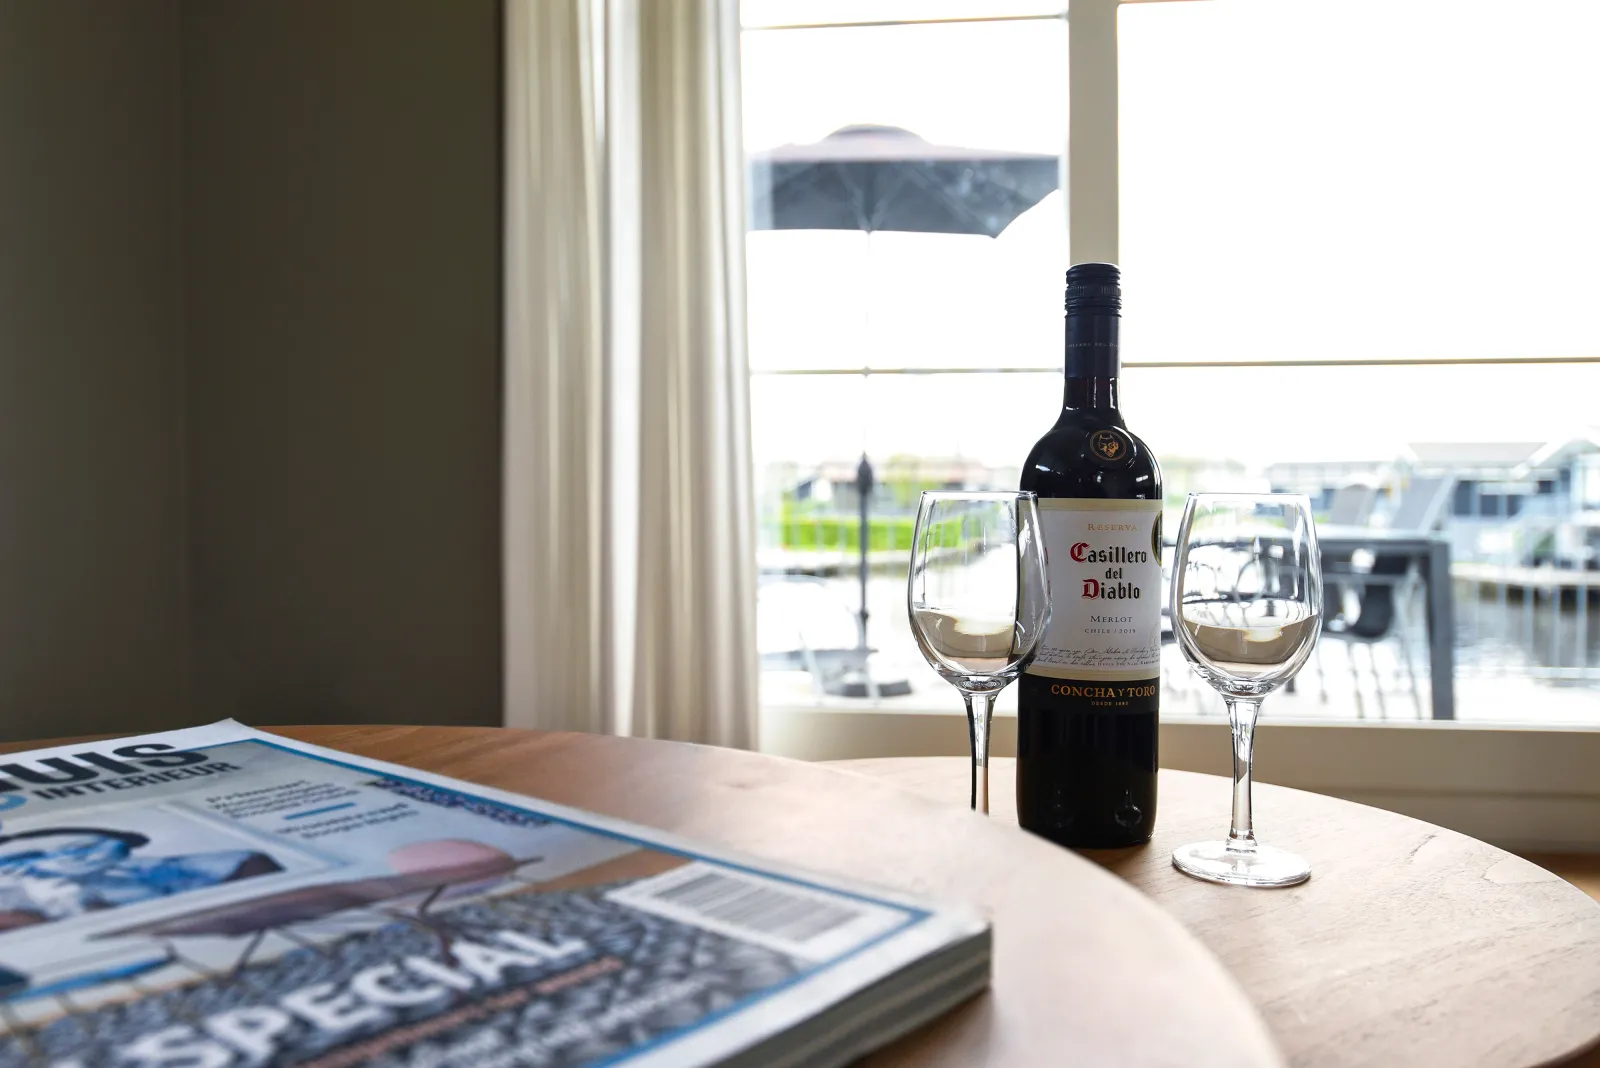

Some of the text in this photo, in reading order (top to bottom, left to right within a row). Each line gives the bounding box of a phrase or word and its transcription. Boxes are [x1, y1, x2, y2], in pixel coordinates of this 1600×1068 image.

[1087, 523, 1138, 531] RESERVA
[1070, 542, 1147, 564] Casillero
[1105, 567, 1123, 580] del
[1081, 578, 1140, 600] Diablo
[1090, 615, 1133, 623] MERLOT
[1051, 684, 1156, 698] CONCHA Y TORO
[31, 761, 243, 800] INTERIEUR
